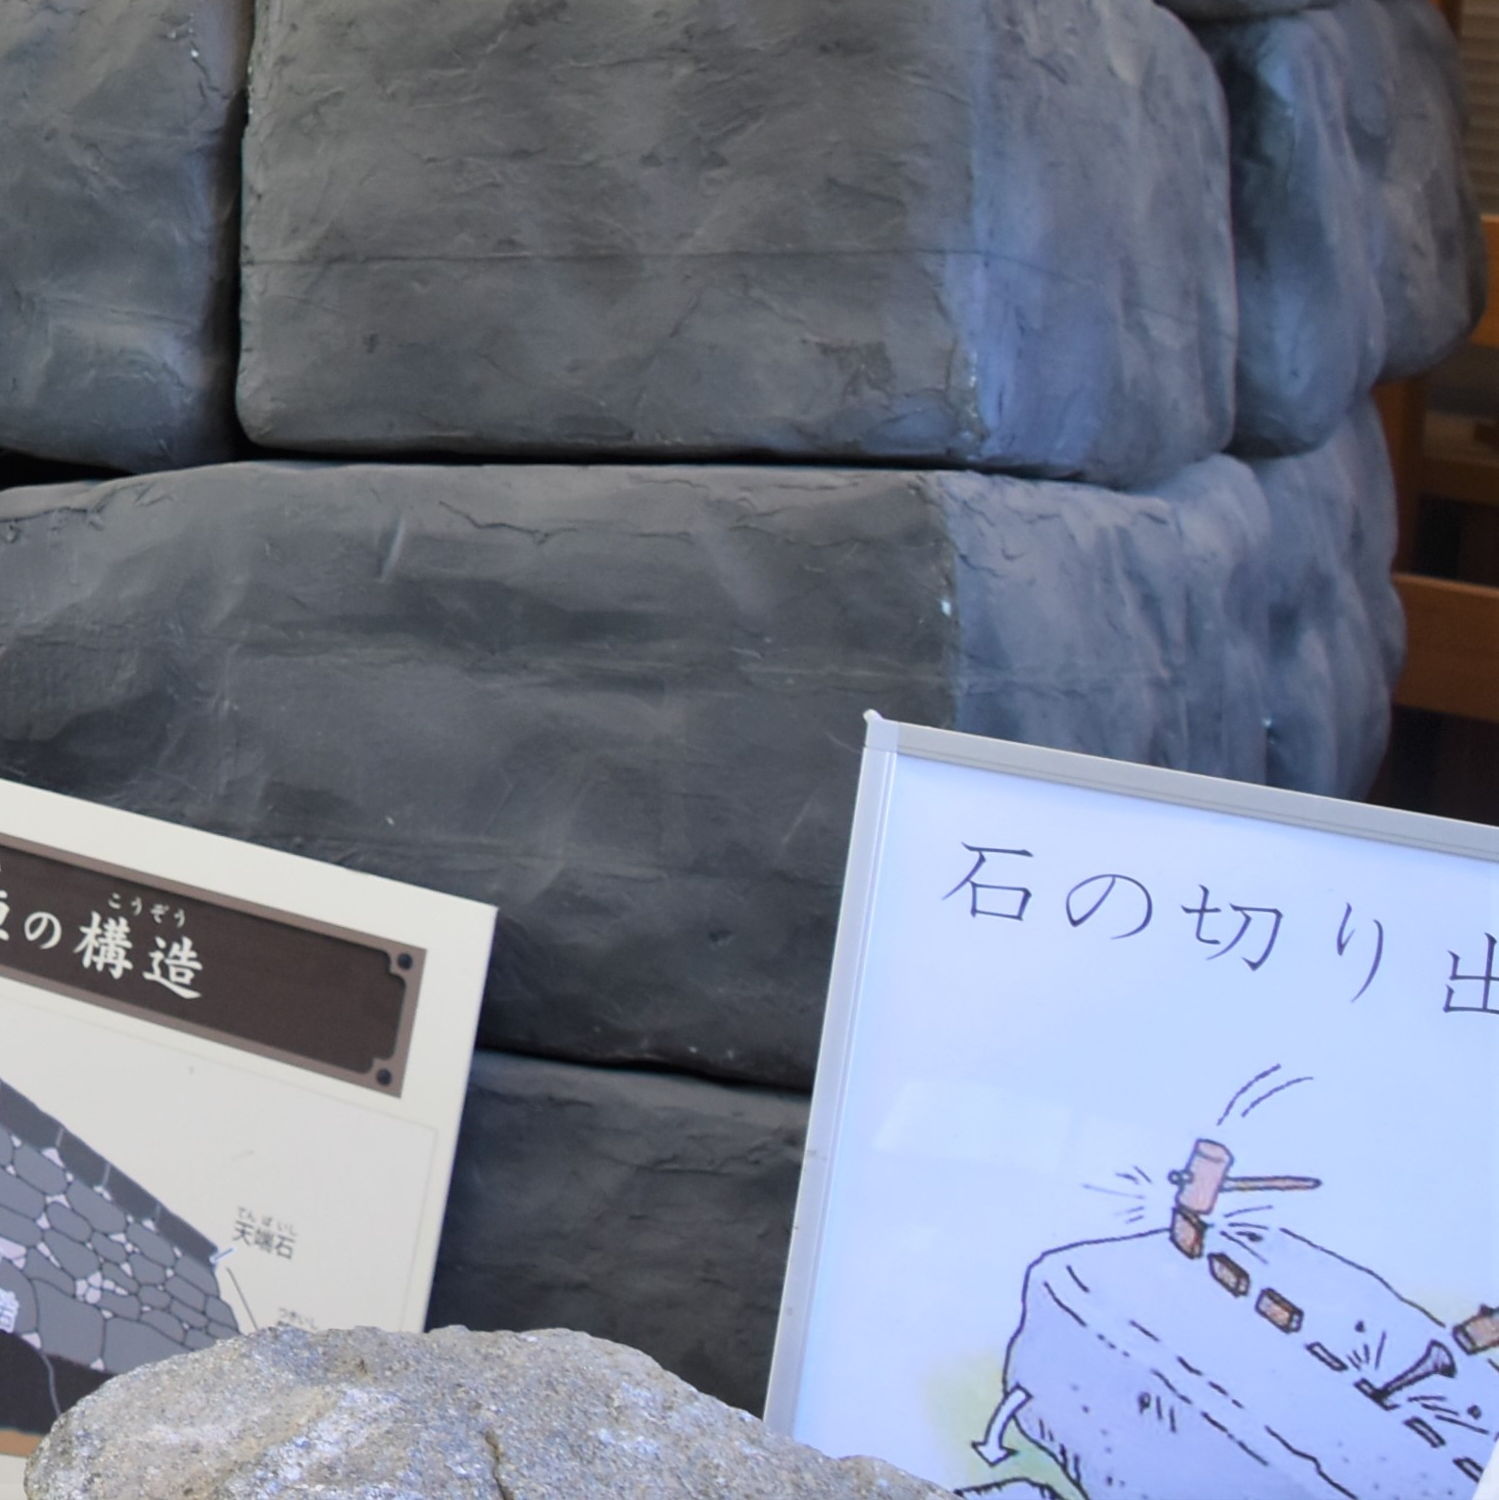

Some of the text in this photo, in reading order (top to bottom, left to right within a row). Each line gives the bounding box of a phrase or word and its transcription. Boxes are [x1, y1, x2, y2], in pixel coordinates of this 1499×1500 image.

[108, 892, 186, 929] こうぞう
[232, 1219, 296, 1260] 天端石
